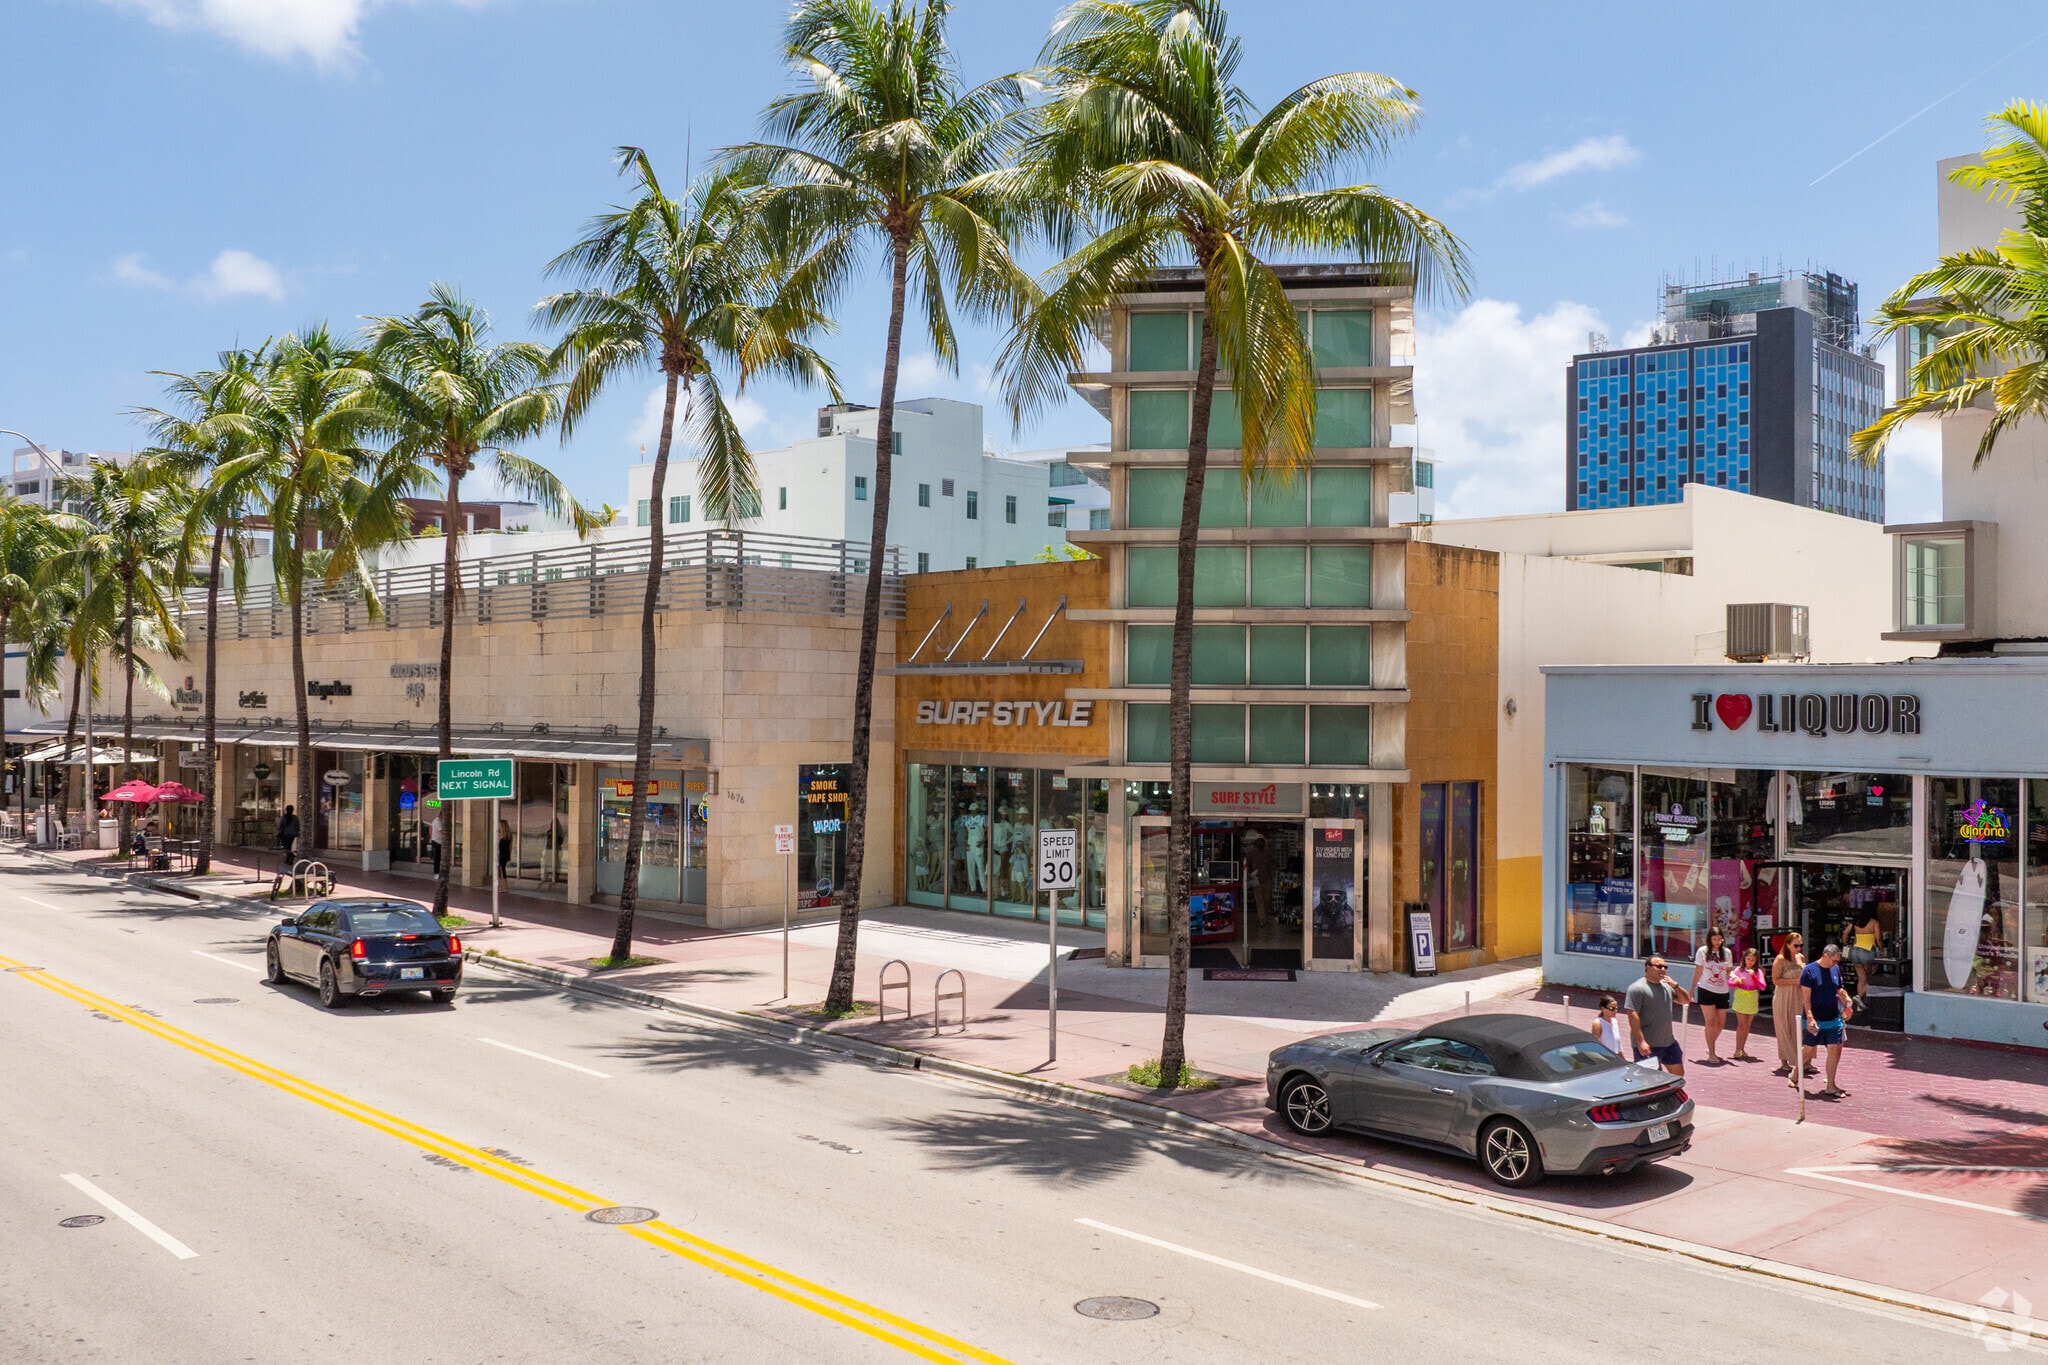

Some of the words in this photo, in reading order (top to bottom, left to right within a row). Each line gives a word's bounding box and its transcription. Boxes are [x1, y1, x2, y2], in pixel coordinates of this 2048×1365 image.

[406, 683, 425, 697] BAR
[915, 701, 991, 725] SURF
[992, 701, 1095, 727] STYLE
[1691, 694, 1712, 731] I
[1757, 693, 1920, 737] LIQUOR
[451, 769, 483, 778] Lincoln
[488, 768, 500, 777] Rd
[441, 781, 468, 790] NEXT
[473, 780, 509, 789] SIGNAL
[617, 782, 634, 795] Vape
[686, 782, 705, 791] PIPES
[811, 781, 837, 790] SMOKE
[426, 800, 442, 808] ATM
[727, 791, 745, 804] 1676
[807, 793, 826, 803] VAPE
[828, 792, 848, 802] SHOP
[1211, 791, 1240, 804] SURF
[1243, 791, 1276, 805] STYLE
[1655, 813, 1673, 822] FUNKY
[1674, 815, 1698, 824] BUDDHA
[812, 818, 841, 834] VAPOR
[1960, 824, 2005, 839] Corona
[1042, 836, 1074, 847] SPEED
[1046, 848, 1071, 859] LIMIT
[1042, 861, 1073, 883] 30
[1418, 934, 1428, 955] P
[1761, 936, 1771, 955] I
